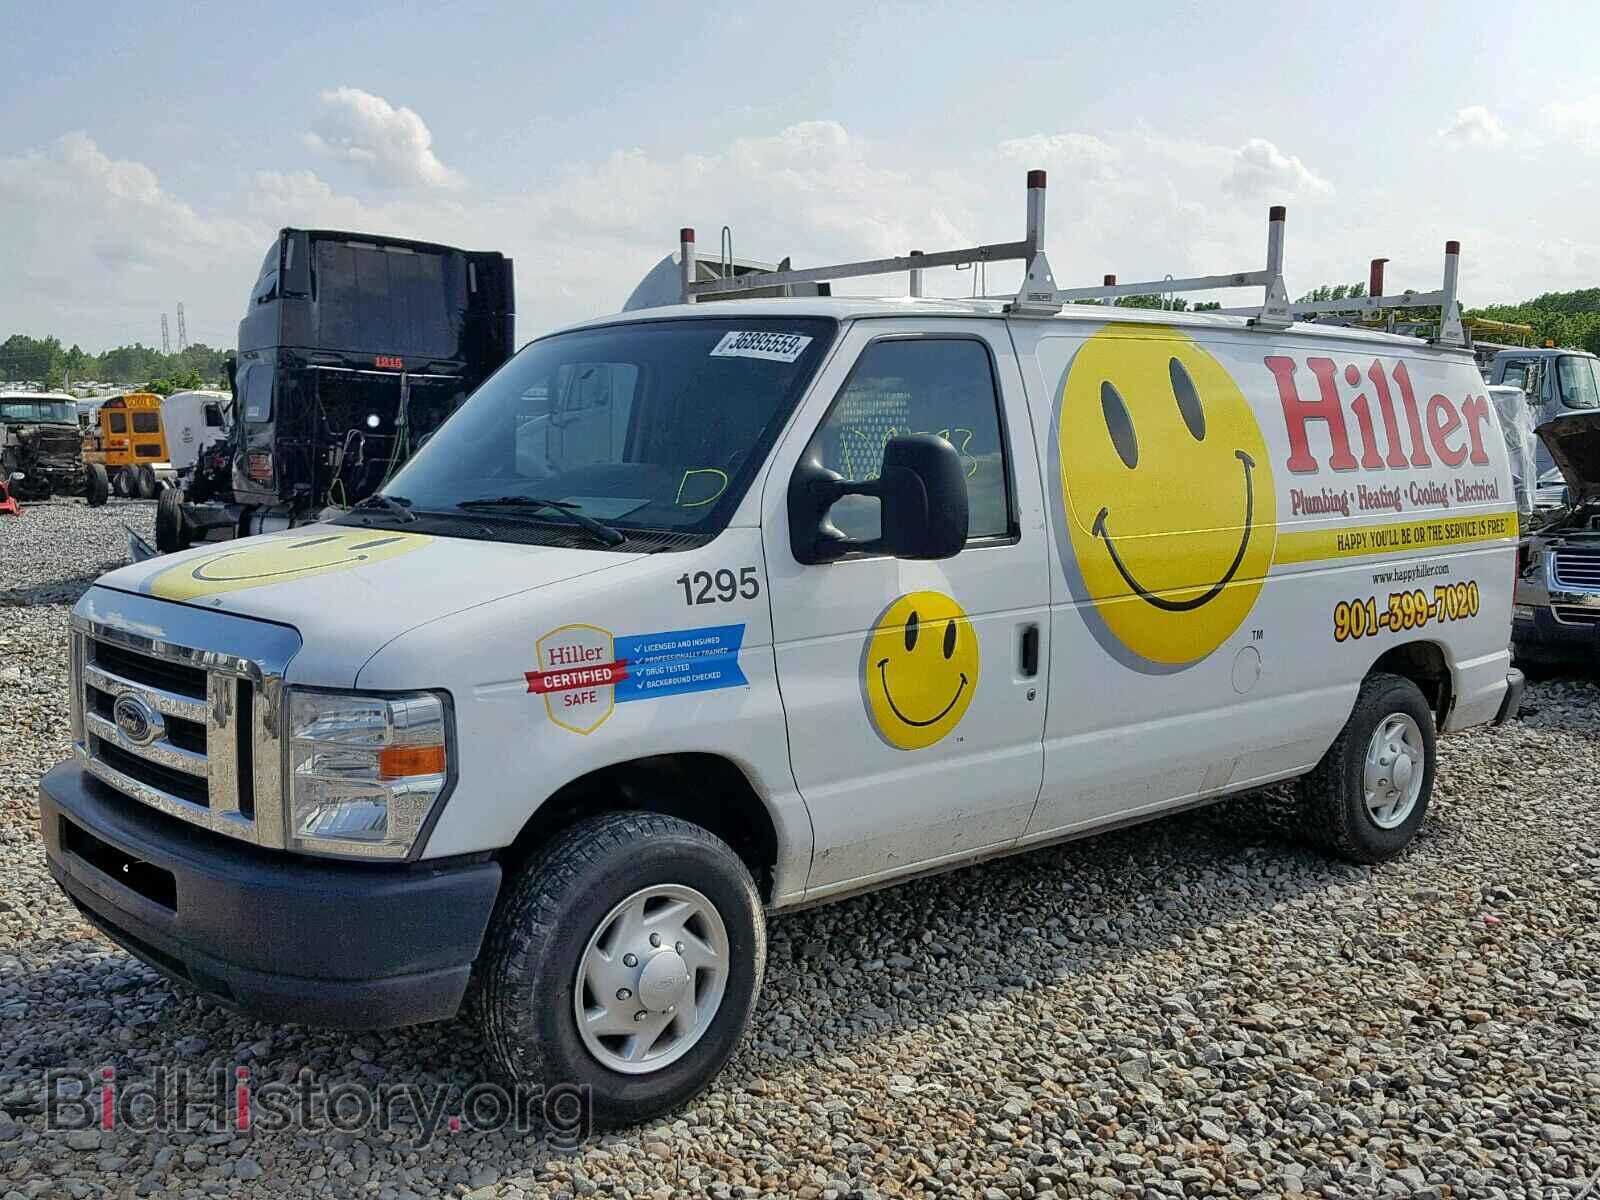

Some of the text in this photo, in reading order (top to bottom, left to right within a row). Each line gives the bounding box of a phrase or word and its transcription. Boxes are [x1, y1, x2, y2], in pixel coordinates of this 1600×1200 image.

[1264, 356, 1490, 474] Hiller
[1290, 478, 1500, 516] Plumbing Heating Cooling Electrical
[1337, 530, 1368, 551] HAPPY
[1370, 528, 1400, 548] YOU'LL
[1401, 527, 1412, 544] BE
[1414, 526, 1426, 543] OR
[1427, 524, 1443, 541] THE
[1445, 521, 1477, 540] SERVICE
[1478, 520, 1486, 536] IS
[1372, 564, 1450, 585] www.happyhiller.com
[677, 567, 760, 606] 1295
[1334, 580, 1480, 642] 901-399-7020
[644, 636, 721, 653] LICENSED AND INSURED
[1251, 629, 1264, 641] TM
[547, 644, 603, 666] Hiller
[543, 668, 612, 689] CERTIFIED
[646, 663, 690, 676] DRUG TESTED
[646, 671, 721, 689] BACKGROUND CHECKED
[563, 690, 598, 707] SAFE
